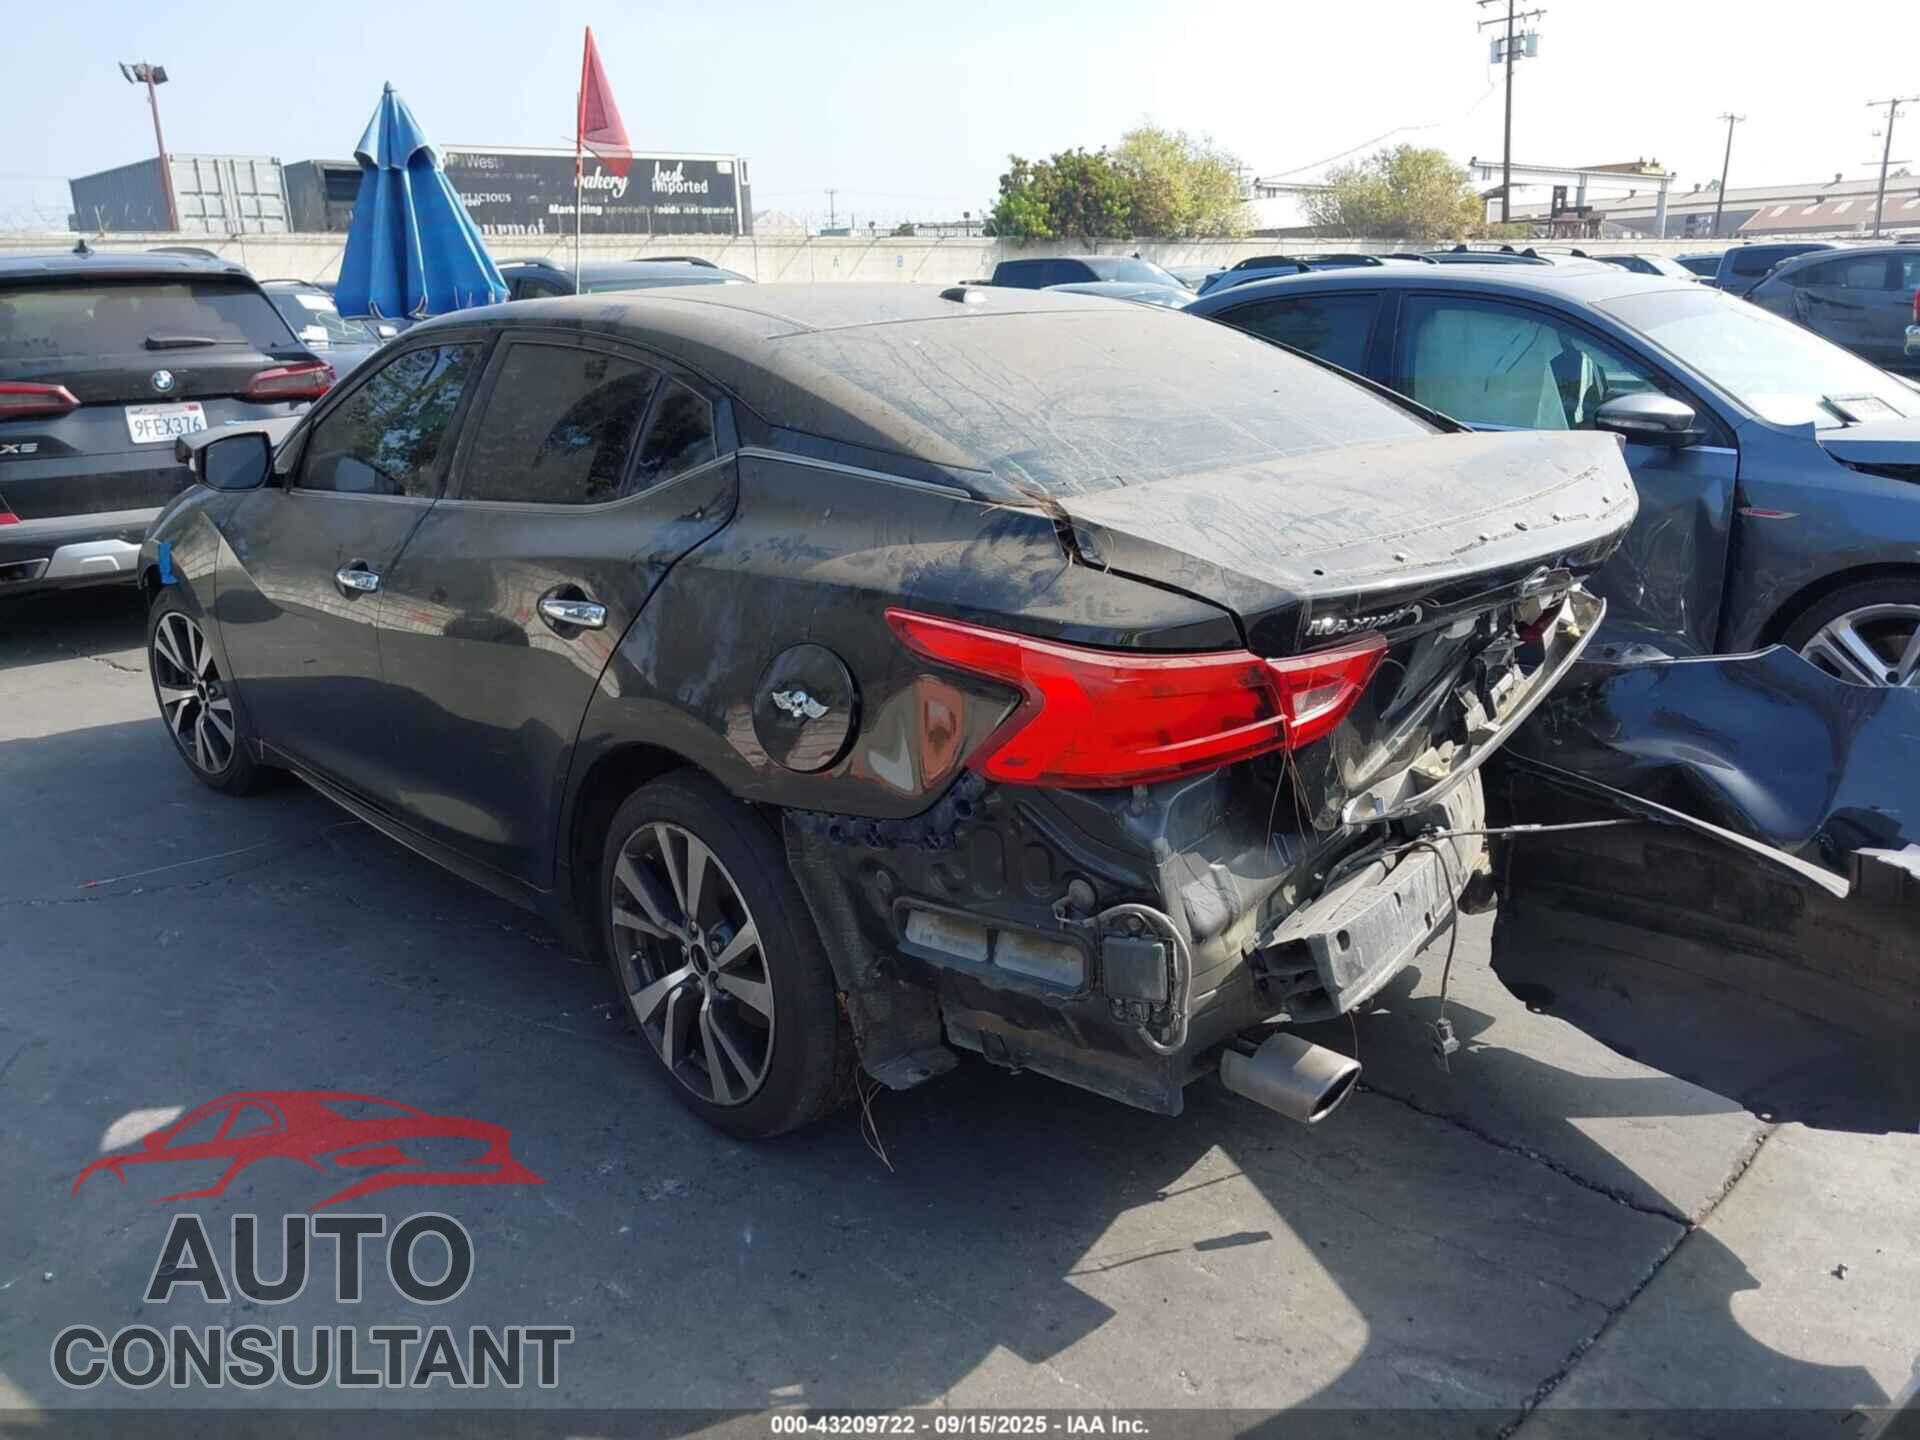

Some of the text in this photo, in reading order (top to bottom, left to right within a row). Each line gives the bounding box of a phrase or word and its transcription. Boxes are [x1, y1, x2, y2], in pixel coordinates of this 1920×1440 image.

[652, 178, 709, 196] imported
[457, 192, 512, 203] ELICIOUS
[548, 203, 603, 216] Markting
[134, 416, 202, 437] 9FEX376
